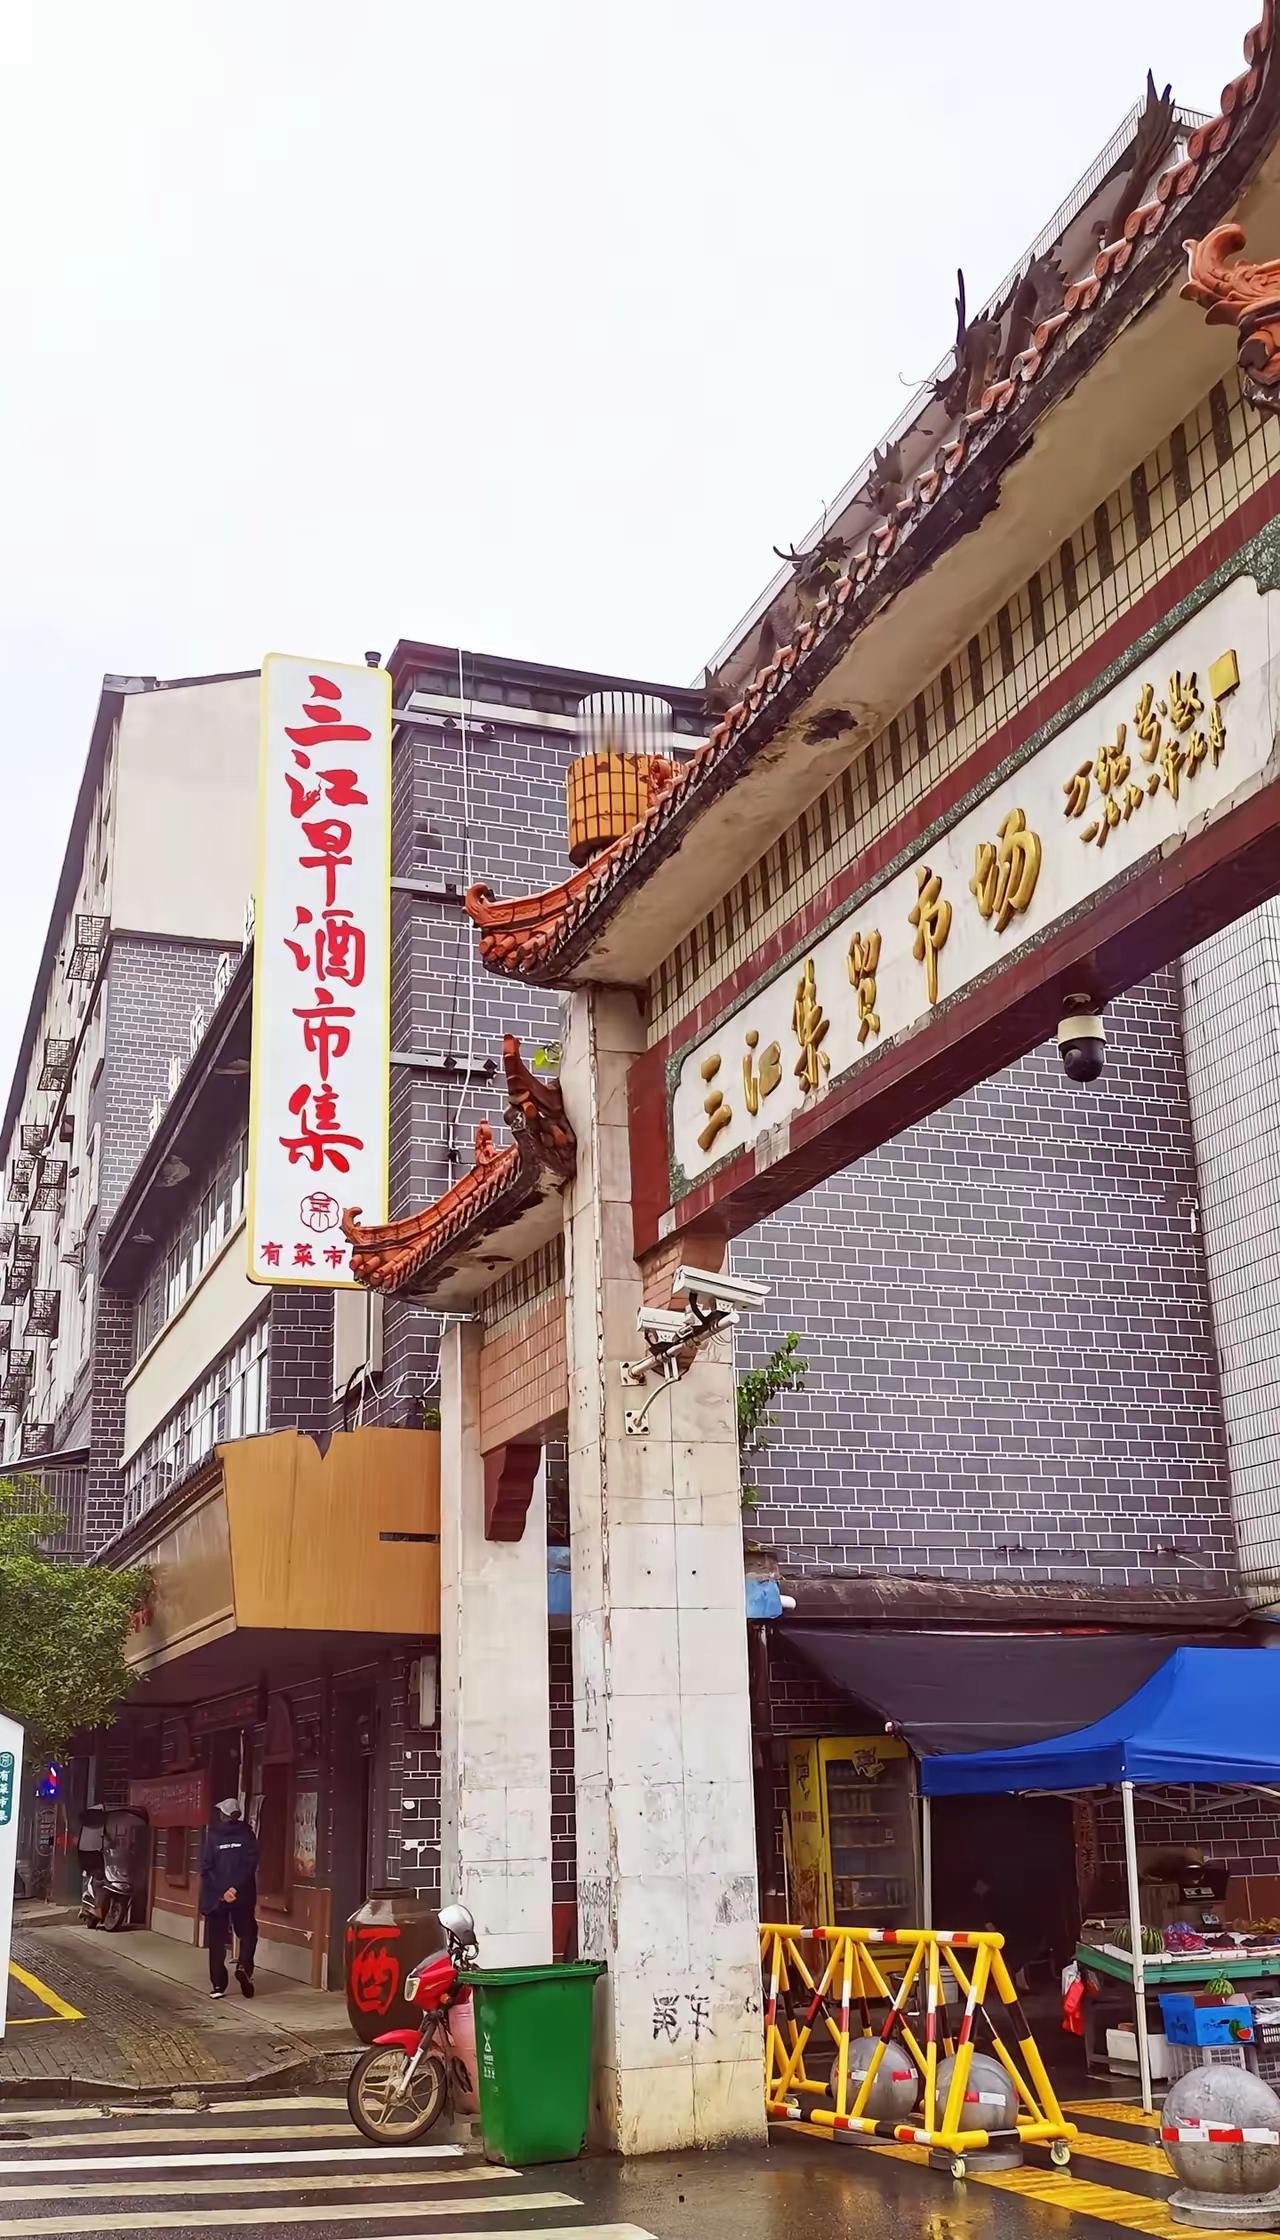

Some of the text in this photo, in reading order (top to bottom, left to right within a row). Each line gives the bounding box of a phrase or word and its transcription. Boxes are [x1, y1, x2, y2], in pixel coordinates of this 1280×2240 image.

[279, 675, 371, 1174] 三江早酒市集
